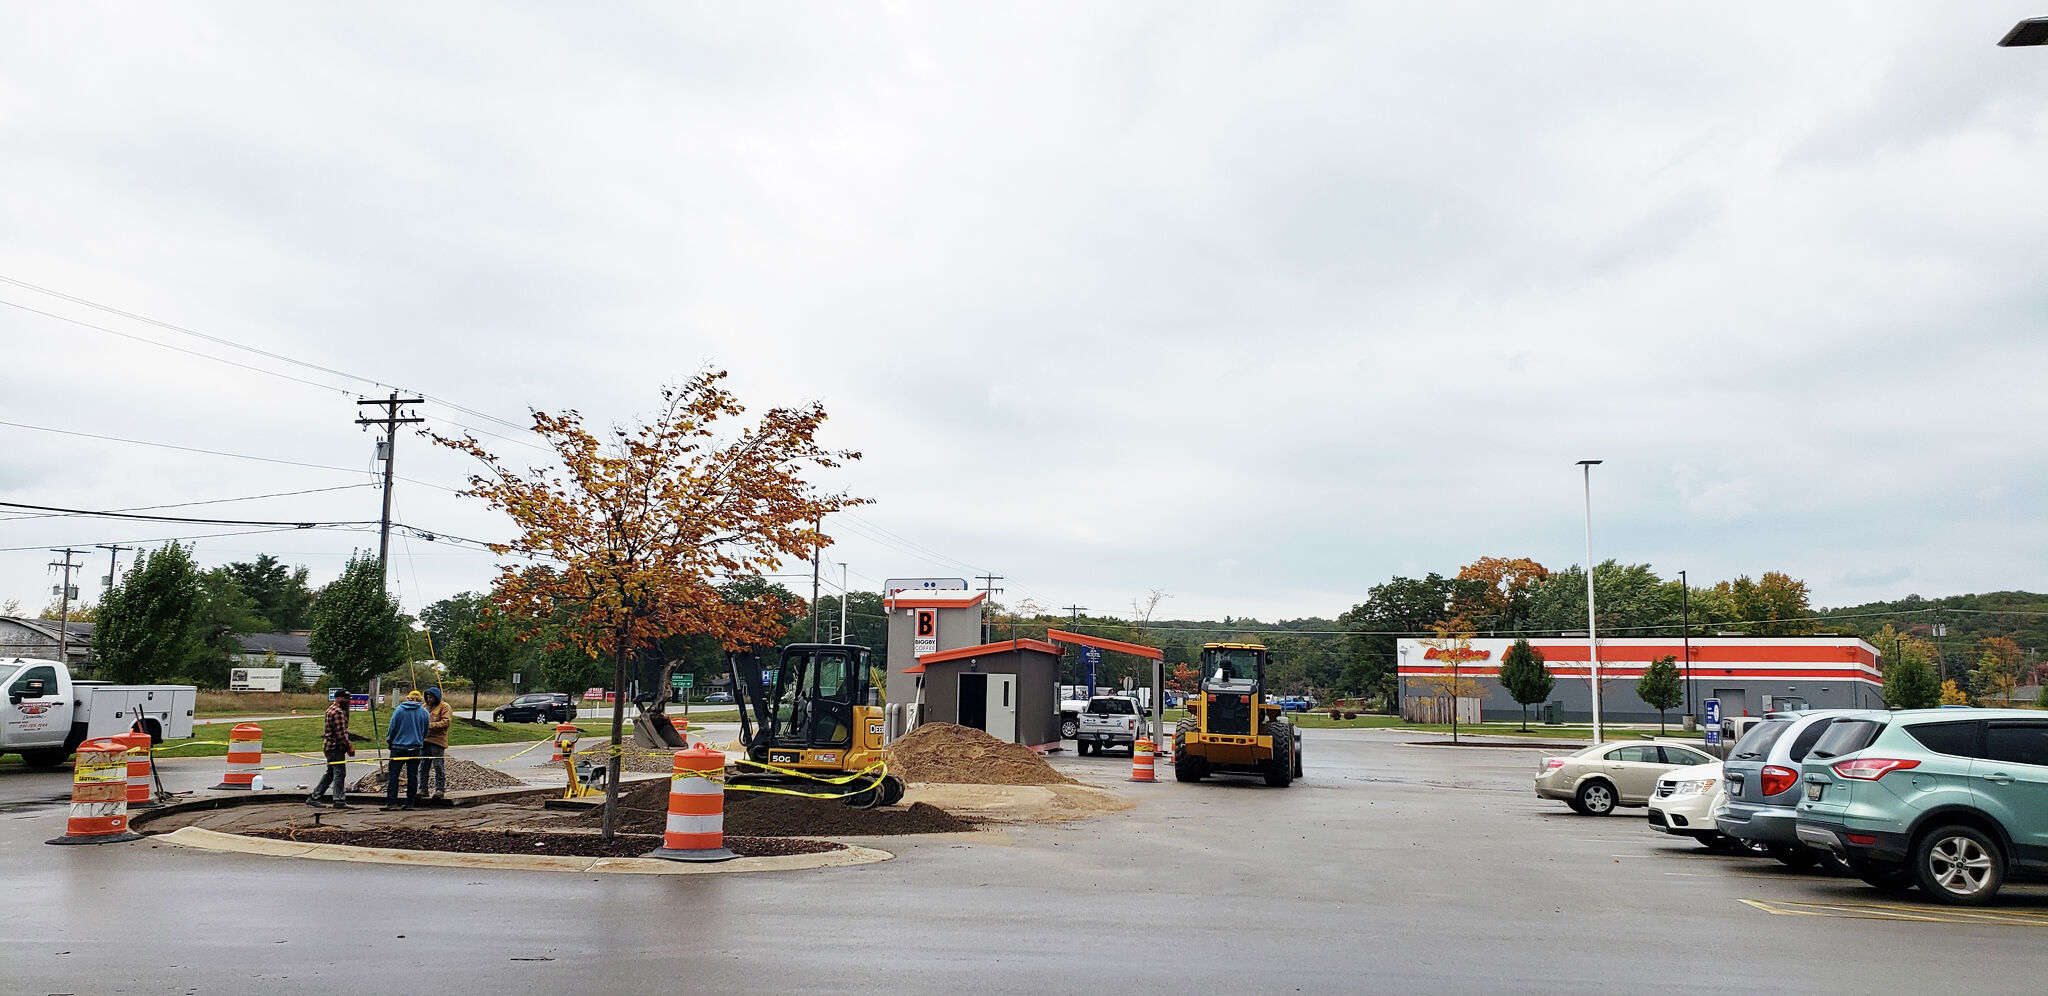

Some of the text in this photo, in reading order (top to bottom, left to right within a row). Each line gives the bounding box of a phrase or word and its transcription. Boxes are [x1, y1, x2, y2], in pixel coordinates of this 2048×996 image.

[919, 612, 933, 636] B
[762, 670, 770, 680] H
[772, 755, 791, 763] 50G
